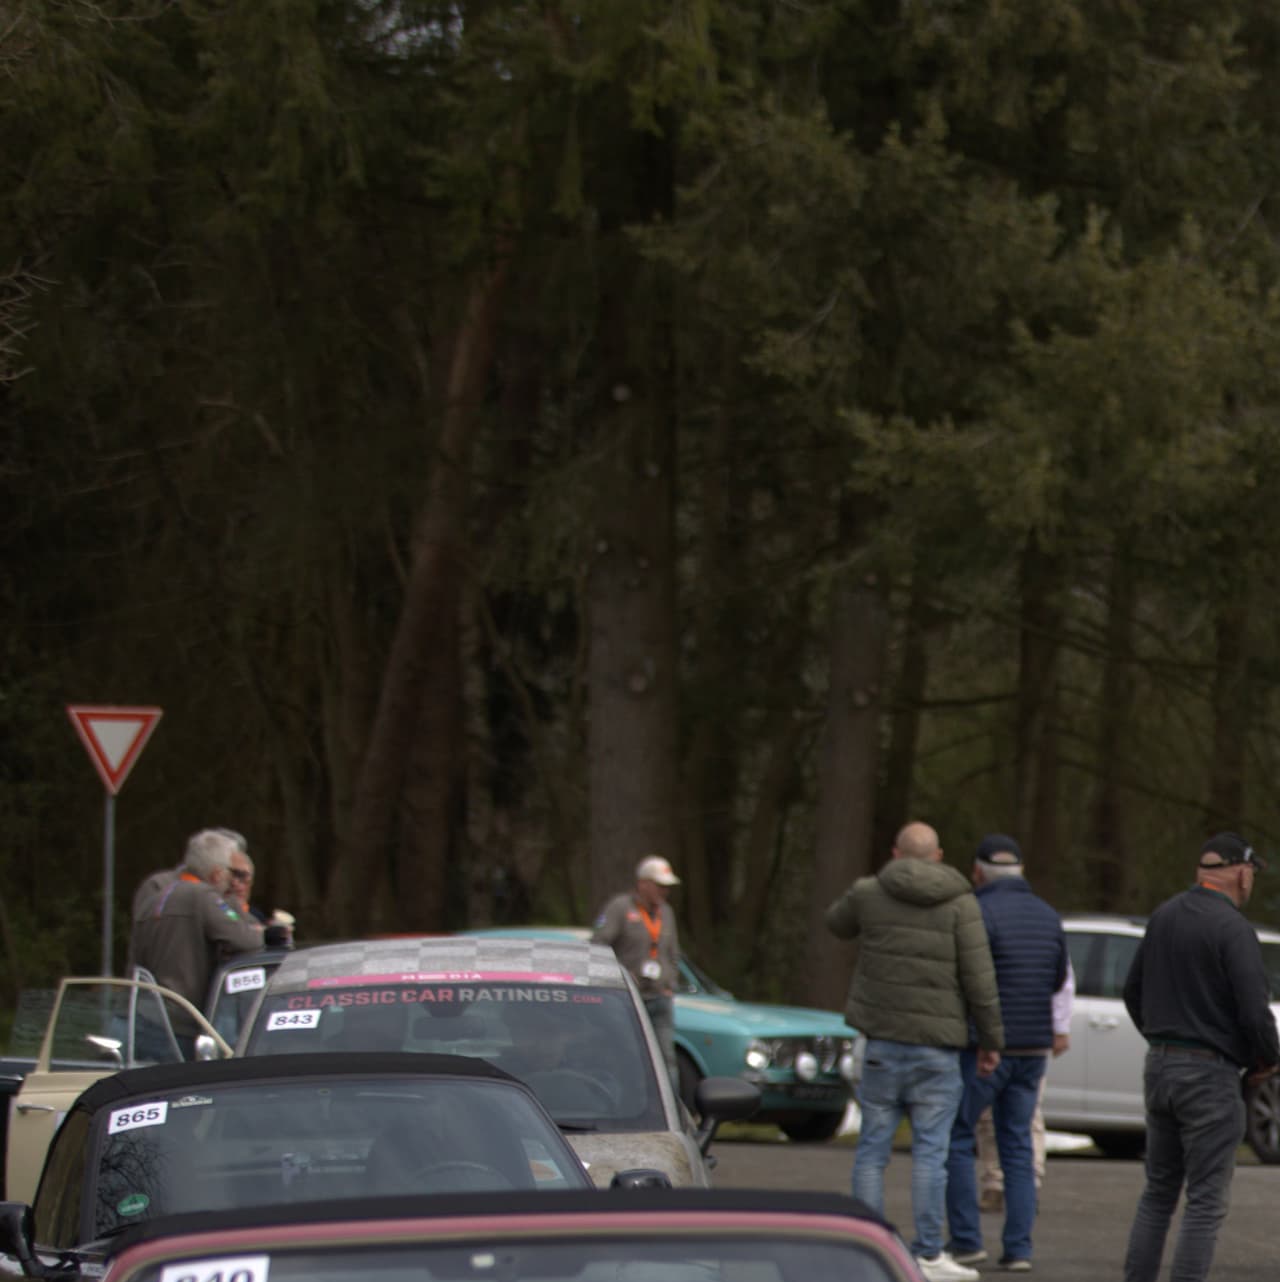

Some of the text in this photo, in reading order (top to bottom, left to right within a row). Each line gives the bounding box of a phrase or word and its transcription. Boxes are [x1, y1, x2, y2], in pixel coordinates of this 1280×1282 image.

[287, 990, 396, 1010] CLASSIC
[402, 988, 453, 1004] CAR
[458, 987, 569, 1003] RATINGS
[274, 1014, 313, 1026] 843
[116, 1107, 160, 1128] 865
